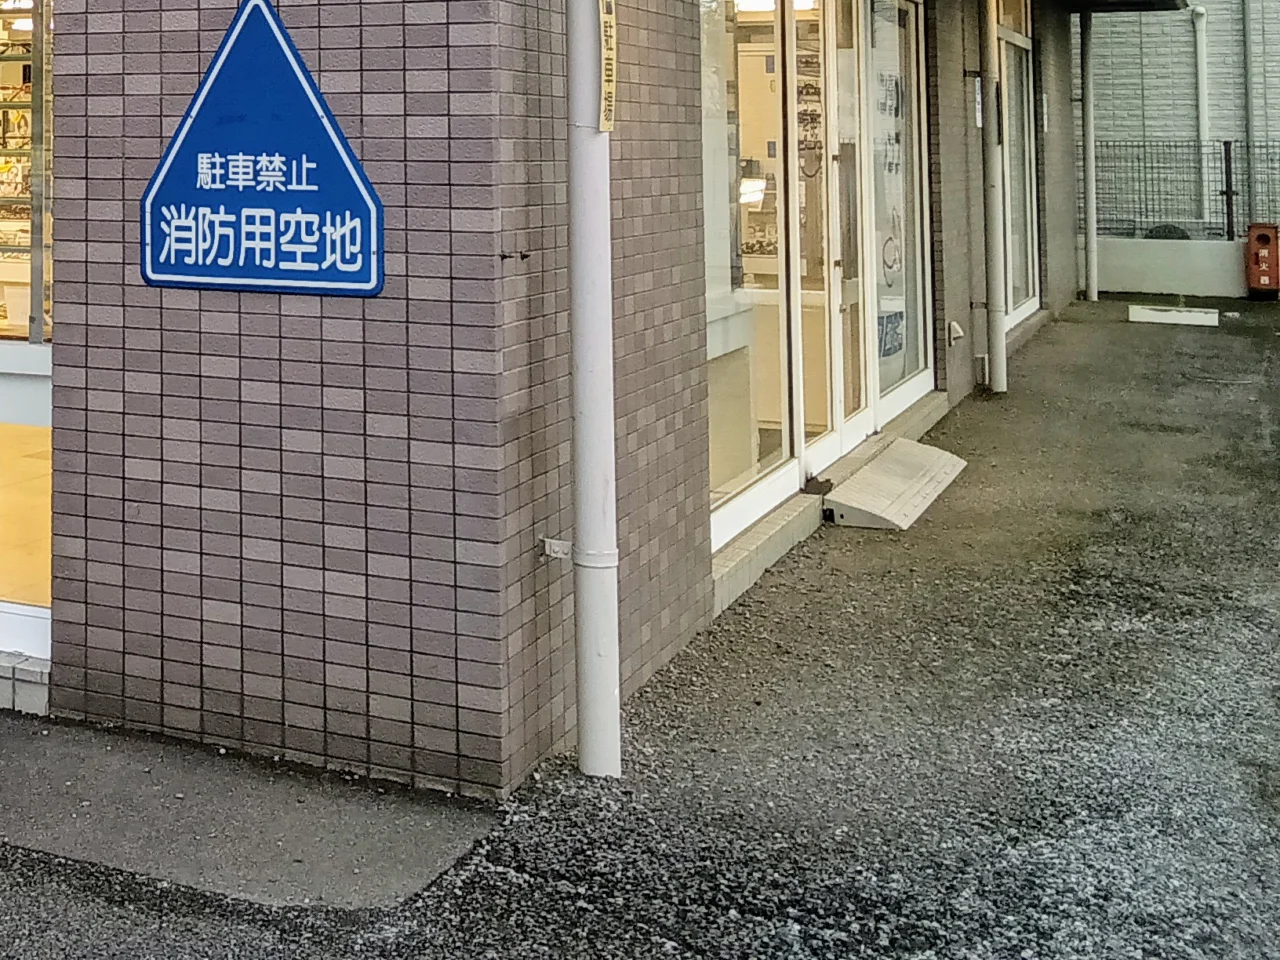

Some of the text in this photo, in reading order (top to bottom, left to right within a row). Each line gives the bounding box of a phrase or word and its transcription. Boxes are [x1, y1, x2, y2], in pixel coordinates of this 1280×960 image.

[196, 152, 319, 193] 駐車禁止
[159, 202, 363, 273] 消防用空地
